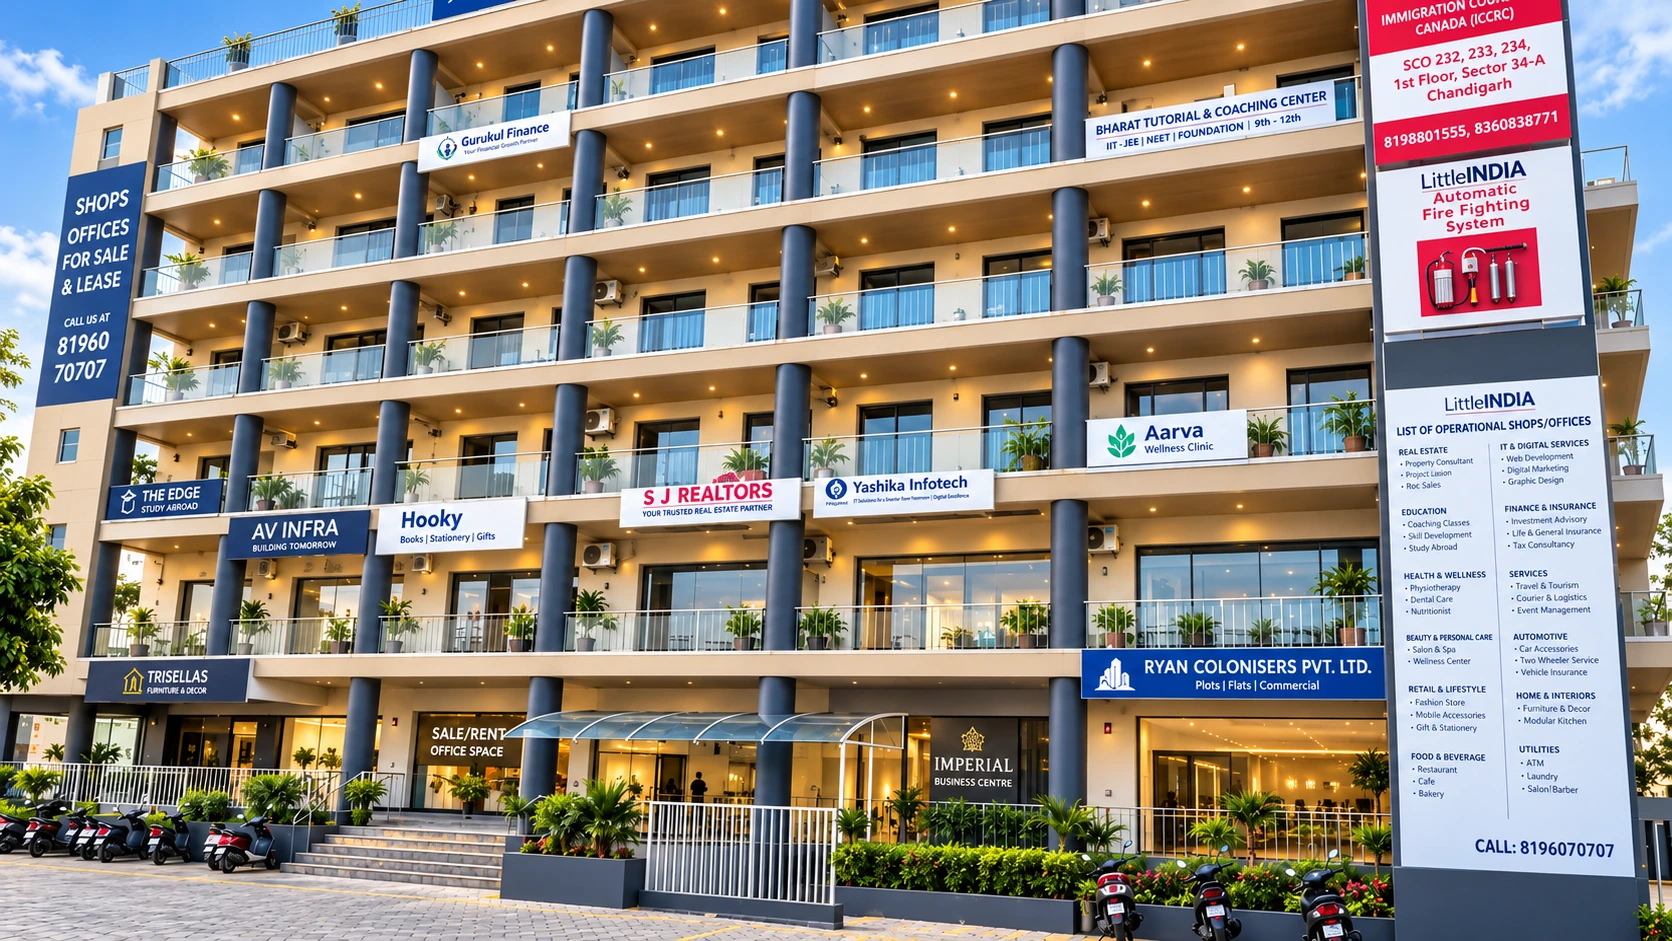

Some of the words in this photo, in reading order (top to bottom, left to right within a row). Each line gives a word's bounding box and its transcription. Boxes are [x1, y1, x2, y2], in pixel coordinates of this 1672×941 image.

[1381, 0, 1466, 26] IMMIGRATION
[1416, 17, 1467, 35] CANADA
[1471, 7, 1513, 27] (ICCRC)
[1404, 56, 1431, 71] SCO
[1436, 51, 1464, 65] 232,
[1469, 45, 1497, 59] 233,
[1501, 39, 1530, 54] 234,
[1394, 78, 1414, 90] 1st
[1419, 72, 1457, 86] Floor,
[1462, 63, 1507, 78] Sector
[1512, 54, 1545, 70] 34-A
[1428, 77, 1512, 101] Chandigarh
[1097, 119, 1140, 135] BHARAT
[1143, 111, 1200, 127] TUTORIAL
[1203, 109, 1212, 119] &
[1215, 98, 1277, 116] COACHING
[1281, 91, 1326, 106] CENTER
[462, 129, 503, 146] Gurukul
[507, 124, 549, 138] Finance
[1107, 141, 1117, 150] IIT
[1147, 133, 1170, 144] NEET
[1178, 121, 1244, 140] FOUNDATION
[1255, 118, 1270, 127] 9th
[1280, 114, 1301, 123] 12th
[1385, 125, 1470, 148] 8198801555,
[1475, 111, 1557, 134] 8360838771
[1422, 160, 1526, 189] LittleINDIA
[1434, 184, 1516, 205] Automatic
[75, 189, 129, 215] SHOPS
[1423, 208, 1453, 220] Fire
[1460, 199, 1529, 216] Fighting
[1445, 216, 1505, 234] System
[68, 218, 129, 244] OFFICES
[63, 251, 90, 270] FOR
[94, 244, 129, 265] SALE
[62, 279, 72, 295] &
[77, 271, 121, 293] LEASE
[64, 317, 84, 327] CALL
[87, 315, 97, 324] US
[99, 313, 110, 322] AT
[57, 331, 109, 355] 81960
[55, 359, 107, 383] 70707
[1445, 391, 1535, 411] LittleINDIA
[1397, 426, 1417, 436] LIST
[1420, 426, 1432, 434] OF
[1436, 422, 1506, 434] OPERATIONAL
[1509, 416, 1591, 430] SHOPS/OFFICES
[1145, 425, 1203, 441] Aarva
[1145, 444, 1185, 453] Wellness
[1188, 442, 1213, 451] Clinic
[1500, 443, 1507, 451] IT
[1510, 442, 1515, 451] &
[1518, 441, 1549, 450] DIGITAL
[1551, 439, 1589, 448] SERVICES
[1399, 448, 1418, 456] REAL
[1420, 446, 1447, 455] ESTATE
[1506, 454, 1523, 463] Web
[1525, 453, 1573, 461] Development
[853, 479, 904, 493] Yashika
[910, 475, 967, 490] Infotech
[143, 489, 165, 501] THE
[168, 486, 200, 500] EDGE
[644, 490, 654, 505] S
[661, 488, 670, 504] J
[678, 482, 773, 503] REALTORS
[142, 505, 165, 513] STUDY
[166, 502, 199, 512] ABROAD
[643, 509, 661, 518] YOUR
[663, 508, 693, 517] TRUSTED
[695, 507, 712, 515] REAL
[714, 505, 738, 514] ESTATE
[740, 503, 772, 512] PARTNER
[1402, 507, 1446, 516] EDUCATION
[1505, 504, 1539, 513] FINANCE
[1542, 503, 1547, 512] &
[1550, 502, 1596, 510] INSURANCE
[402, 509, 462, 531] Hooky
[252, 522, 278, 539] AV
[282, 519, 338, 538] INFRA
[401, 535, 423, 543] Books
[430, 535, 470, 543] Stationery
[477, 532, 495, 540] Gifts
[253, 543, 287, 552] BUILDING
[290, 541, 336, 549] TOMORROW
[1409, 545, 1429, 553] Study
[1432, 543, 1457, 551] Abroad
[1513, 541, 1526, 550] Tax
[1528, 541, 1575, 549] Consultancy
[1404, 572, 1434, 580] HEALTH
[1437, 572, 1442, 580] &
[1445, 570, 1486, 579] WELLNESS
[1509, 569, 1548, 578] SERVICES
[1410, 584, 1460, 593] Physiotherapy
[1411, 595, 1434, 604] Dental
[1436, 595, 1453, 604] Care
[1517, 606, 1538, 615] Event
[1541, 606, 1590, 615] Management
[1407, 634, 1431, 642] BEAUTY
[1433, 634, 1438, 642] &
[1440, 633, 1473, 642] PERSONAL
[1475, 633, 1492, 641] CARE
[1513, 632, 1567, 641] AUTOMOTIVE
[1519, 644, 1532, 653] Car
[1534, 645, 1578, 653] Accessories
[1145, 660, 1187, 673] RYAN
[1194, 659, 1296, 674] COLONISERS
[1302, 660, 1335, 673] PVT.
[1340, 660, 1371, 673] LTD.
[1413, 657, 1445, 665] Wellness
[1447, 657, 1470, 665] Center
[148, 670, 208, 683] TRISELLAS
[1521, 668, 1548, 677] Vehicle
[1551, 668, 1587, 677] Insurance
[181, 686, 185, 695] &
[186, 686, 206, 695] DECOR
[1196, 680, 1220, 690] Plots
[1229, 680, 1251, 690] Flats
[1260, 680, 1319, 690] Commercial
[1409, 685, 1435, 694] RETAIL
[1438, 685, 1443, 694] &
[1446, 685, 1485, 694] LIFESTYLE
[1516, 691, 1541, 700] HOME
[1544, 691, 1549, 700] &
[1552, 691, 1595, 700] INTERIORS
[1416, 698, 1443, 707] Fashion
[1446, 698, 1465, 707] Store
[1523, 704, 1558, 713] Furniture
[1560, 704, 1565, 713] &
[1568, 704, 1590, 713] Decor
[1524, 716, 1555, 725] Modular
[1558, 716, 1587, 725] Kitchen
[432, 727, 507, 742] SALE/RENT
[431, 745, 466, 756] OFFICE
[469, 746, 503, 756] SPACE
[1519, 745, 1559, 754] UTILITIES
[1412, 752, 1433, 761] FOOD
[1436, 752, 1441, 761] &
[1444, 753, 1485, 762] BEVERAGE
[1526, 758, 1544, 767] ATM
[935, 757, 1013, 772] IMPERIAL
[1418, 765, 1457, 773] Restaurant
[935, 778, 975, 786] BUSINESS
[978, 779, 1012, 787] CENTRE
[1418, 777, 1435, 785] Cafe
[1527, 773, 1558, 782] Laundry
[1419, 790, 1444, 799] Bakery
[1476, 839, 1516, 853] CALL:
[1521, 841, 1614, 857] 8196070707
